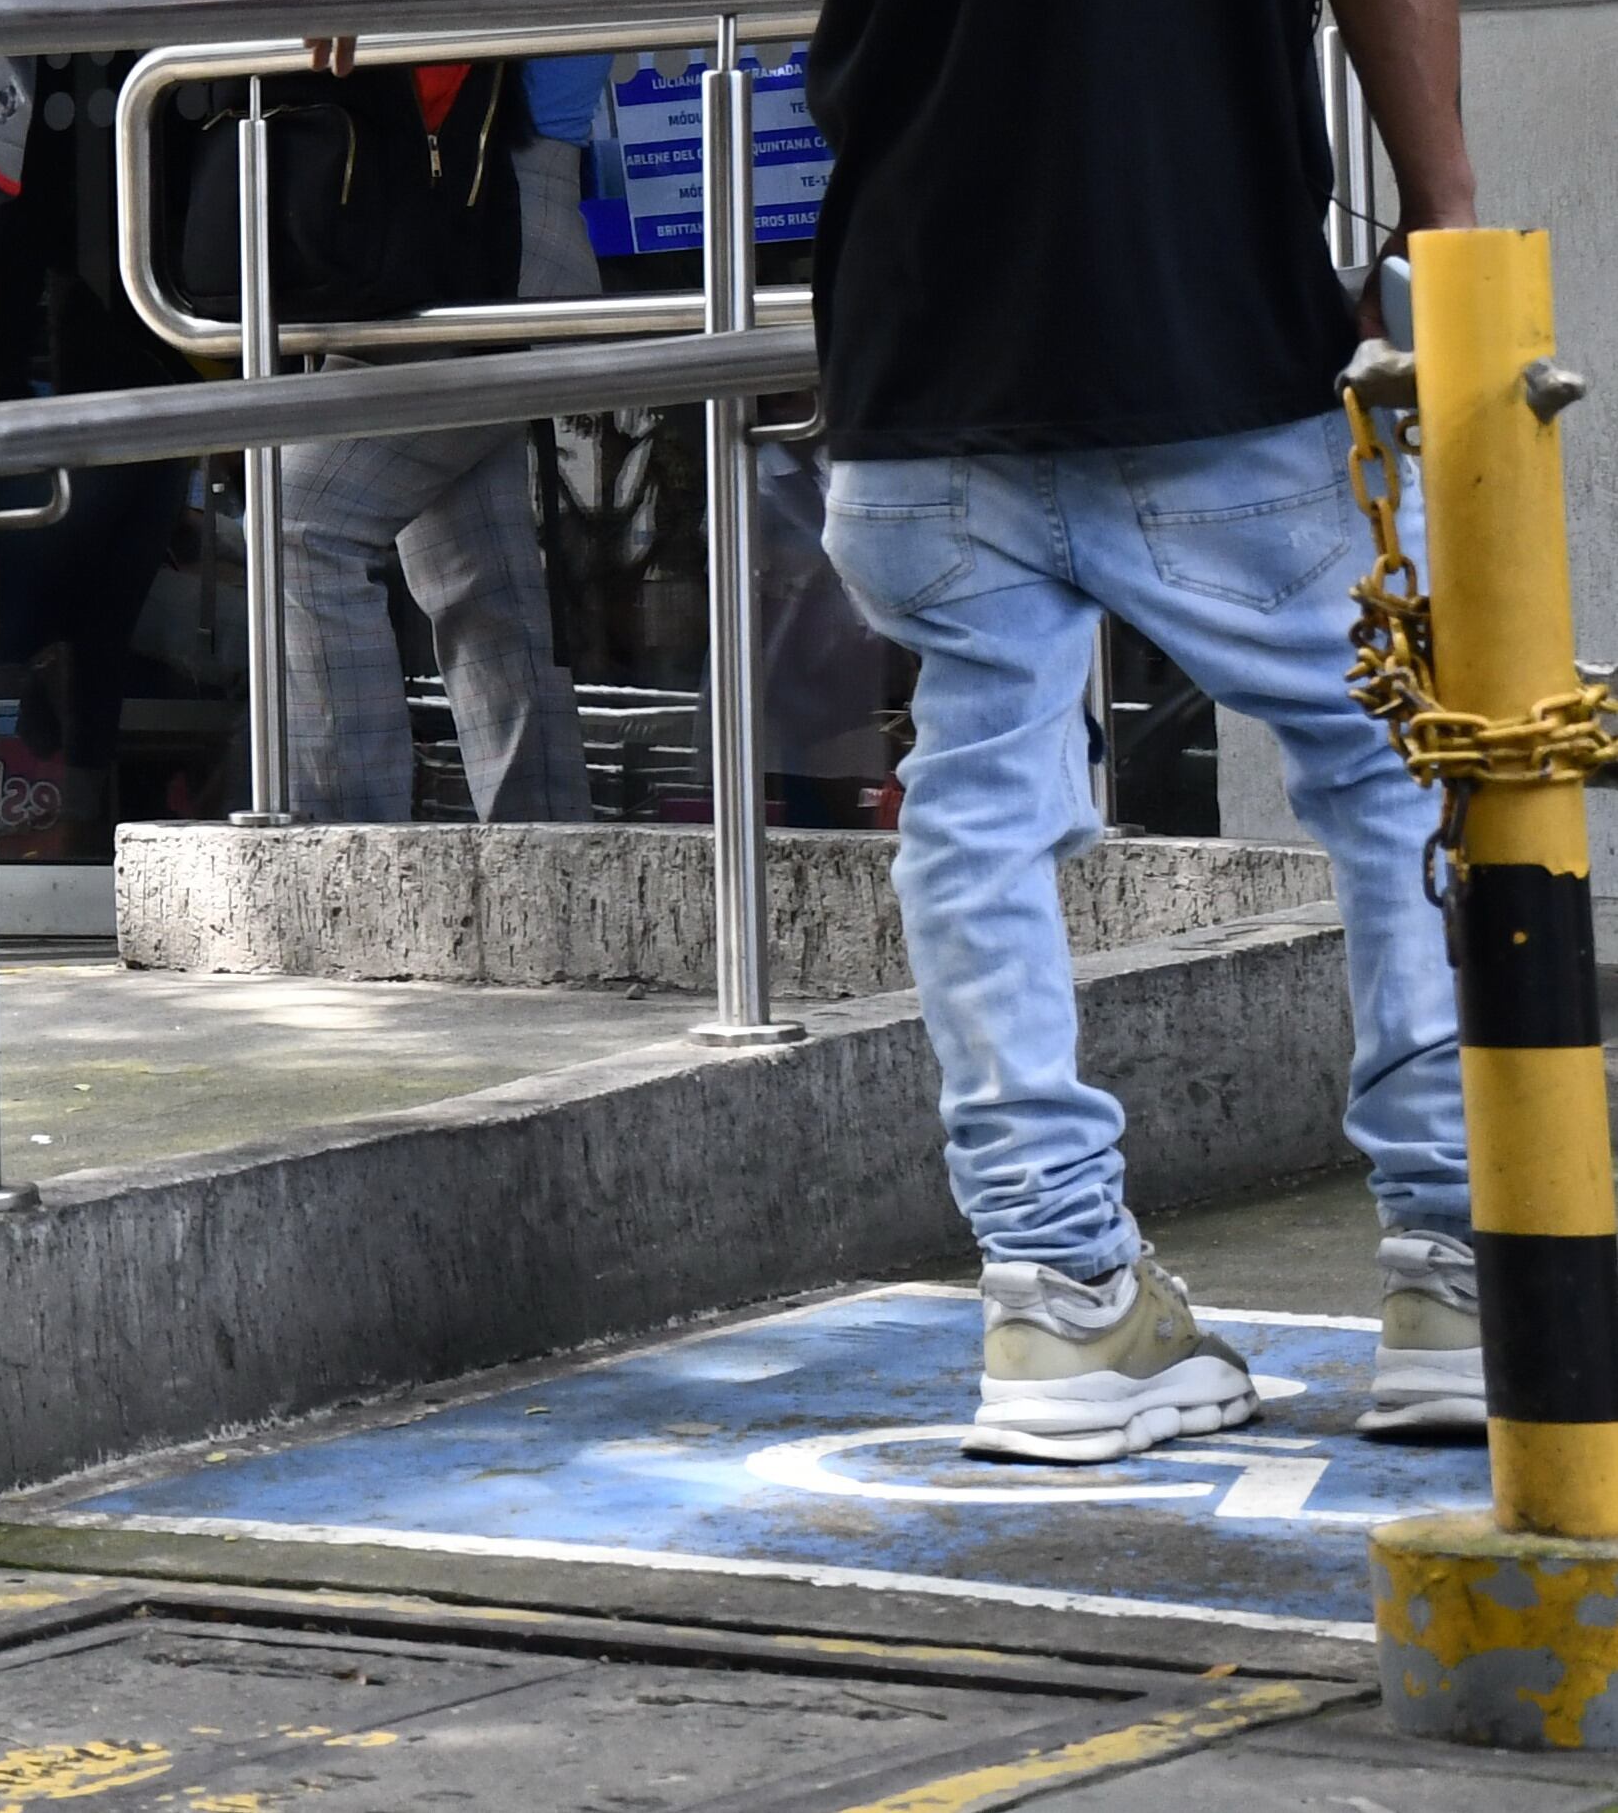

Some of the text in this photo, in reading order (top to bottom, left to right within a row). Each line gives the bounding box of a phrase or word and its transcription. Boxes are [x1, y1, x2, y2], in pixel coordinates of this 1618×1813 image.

[651, 63, 803, 90] LUCIANA RANADA
[668, 110, 703, 126] MÓDU
[626, 151, 671, 165] ARLENE
[673, 149, 695, 162] DEL
[679, 175, 828, 199] MÓD TE-1
[656, 211, 818, 237] BRITTAN EROS RIAS
